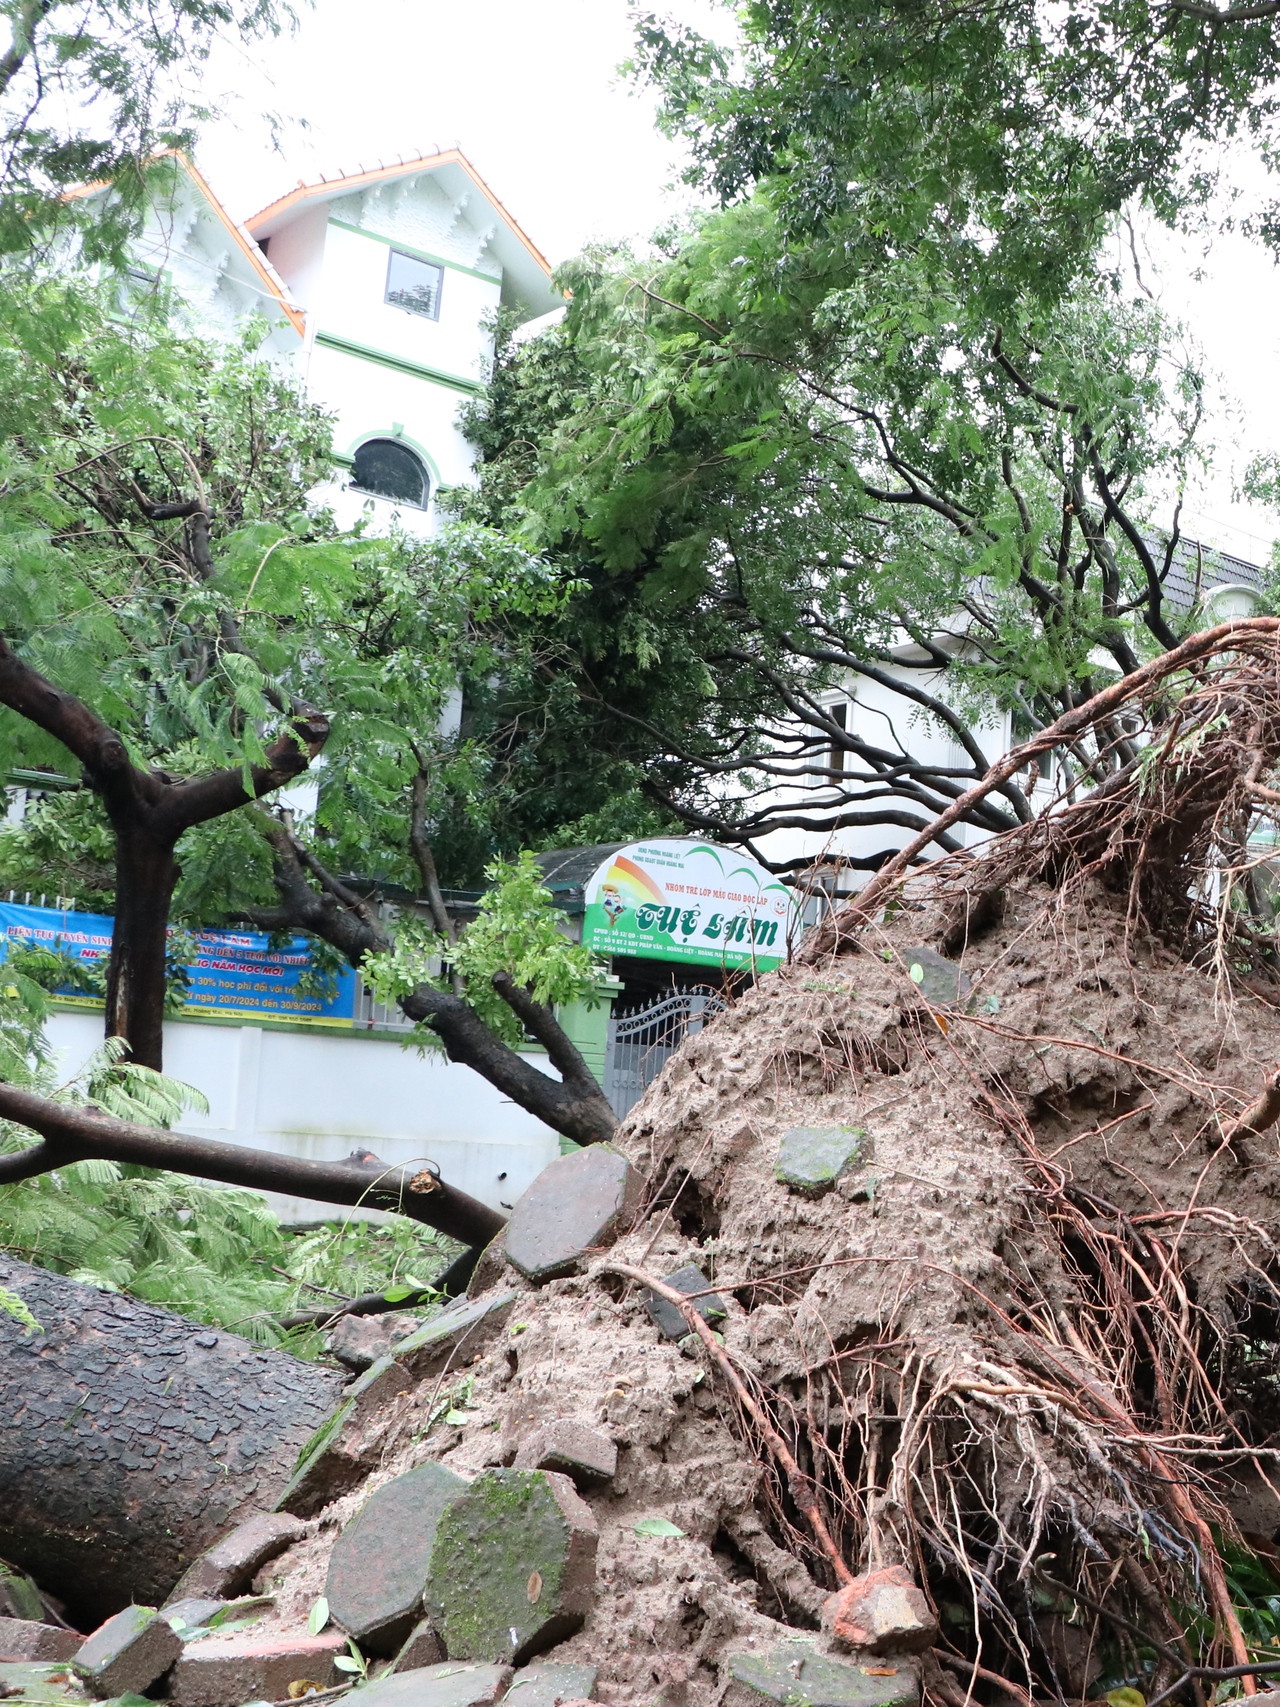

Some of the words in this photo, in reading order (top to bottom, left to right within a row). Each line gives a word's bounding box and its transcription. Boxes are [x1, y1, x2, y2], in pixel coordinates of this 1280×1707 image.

[665, 882, 684, 892] NHÓM
[727, 890, 742, 900] GIÁO
[636, 903, 701, 943] TUỆ
[702, 910, 778, 946] LÂM
[8, 925, 32, 937] LIÊN
[35, 930, 54, 941] TỤC
[56, 931, 88, 944] TUYỂN
[216, 946, 234, 958] ĐẾN
[211, 959, 236, 972] NĂM
[238, 964, 261, 975] HỌC
[262, 965, 284, 976] MỚI
[198, 976, 216, 987] 30%
[219, 980, 234, 989] học
[196, 992, 216, 1004] ngày
[219, 994, 260, 1006] 20/7/2024
[262, 998, 278, 1008] đến
[280, 1000, 322, 1011] 30/9/2024
